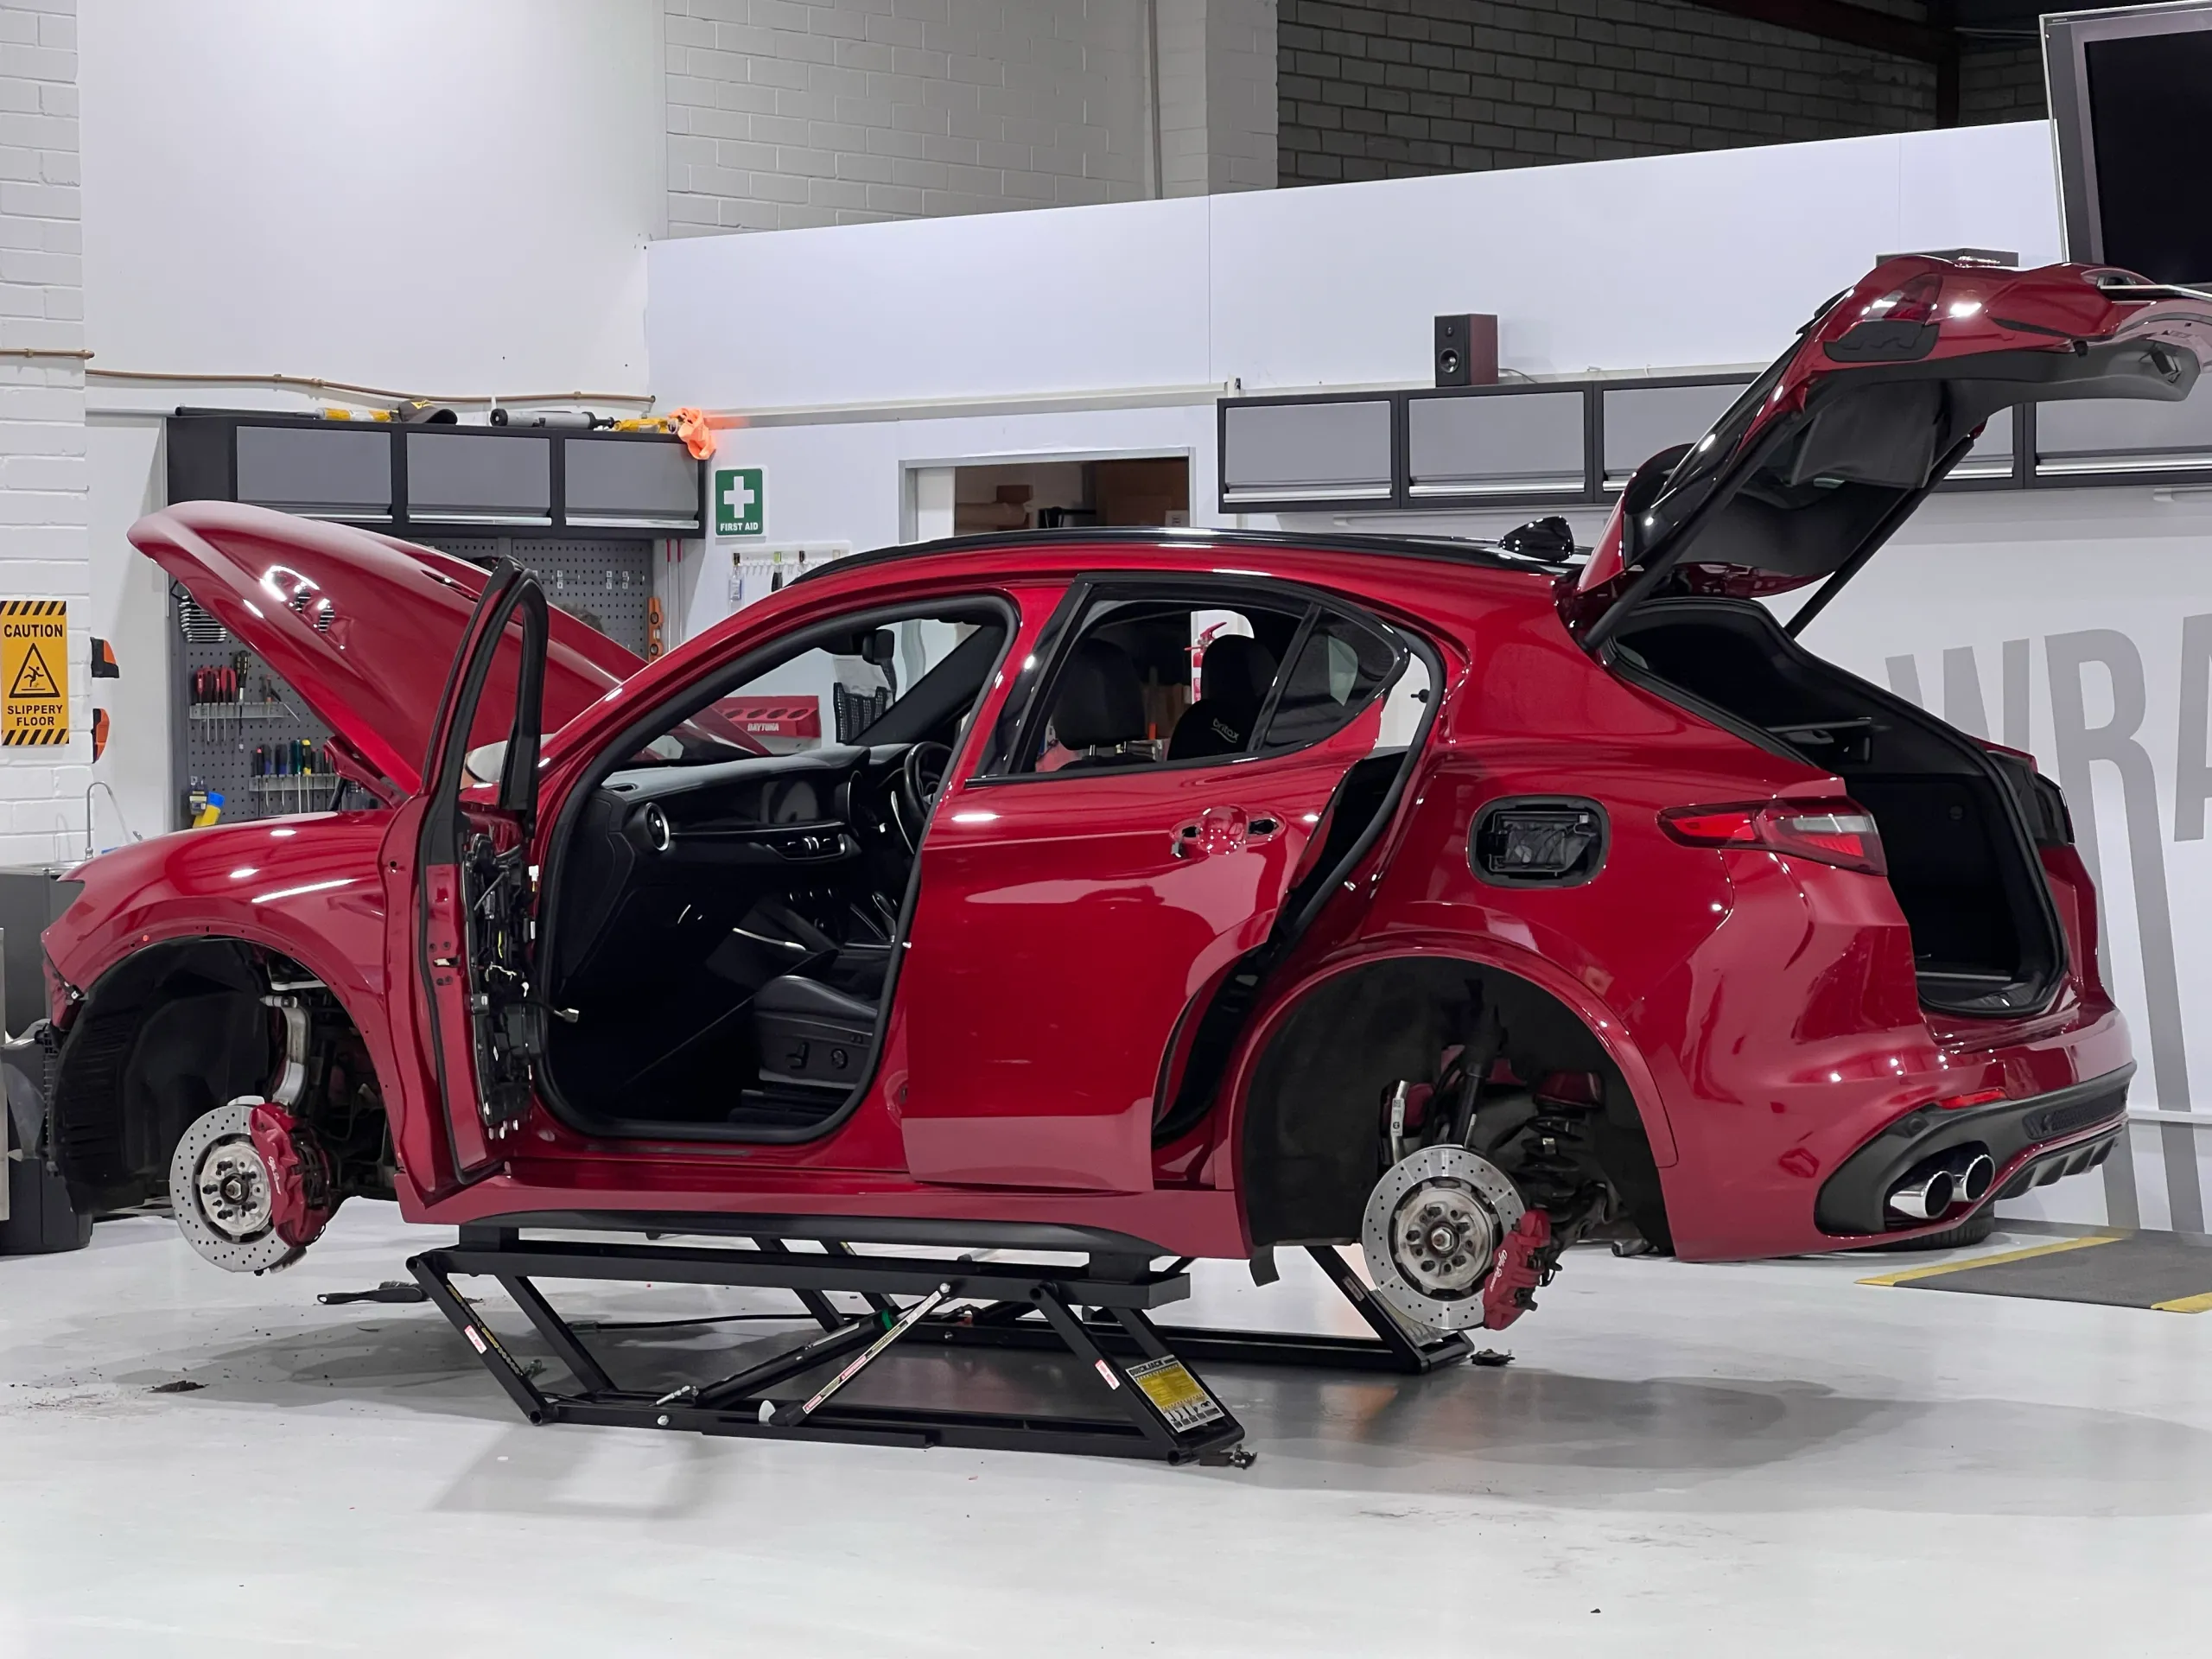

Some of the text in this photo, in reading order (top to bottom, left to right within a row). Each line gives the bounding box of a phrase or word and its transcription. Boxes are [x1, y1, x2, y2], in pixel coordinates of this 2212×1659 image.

[720, 522, 759, 531] FIRST AID
[3, 624, 63, 638] CAUTION
[7, 704, 63, 715] SLIPPERY
[16, 716, 54, 727] FLOOR
